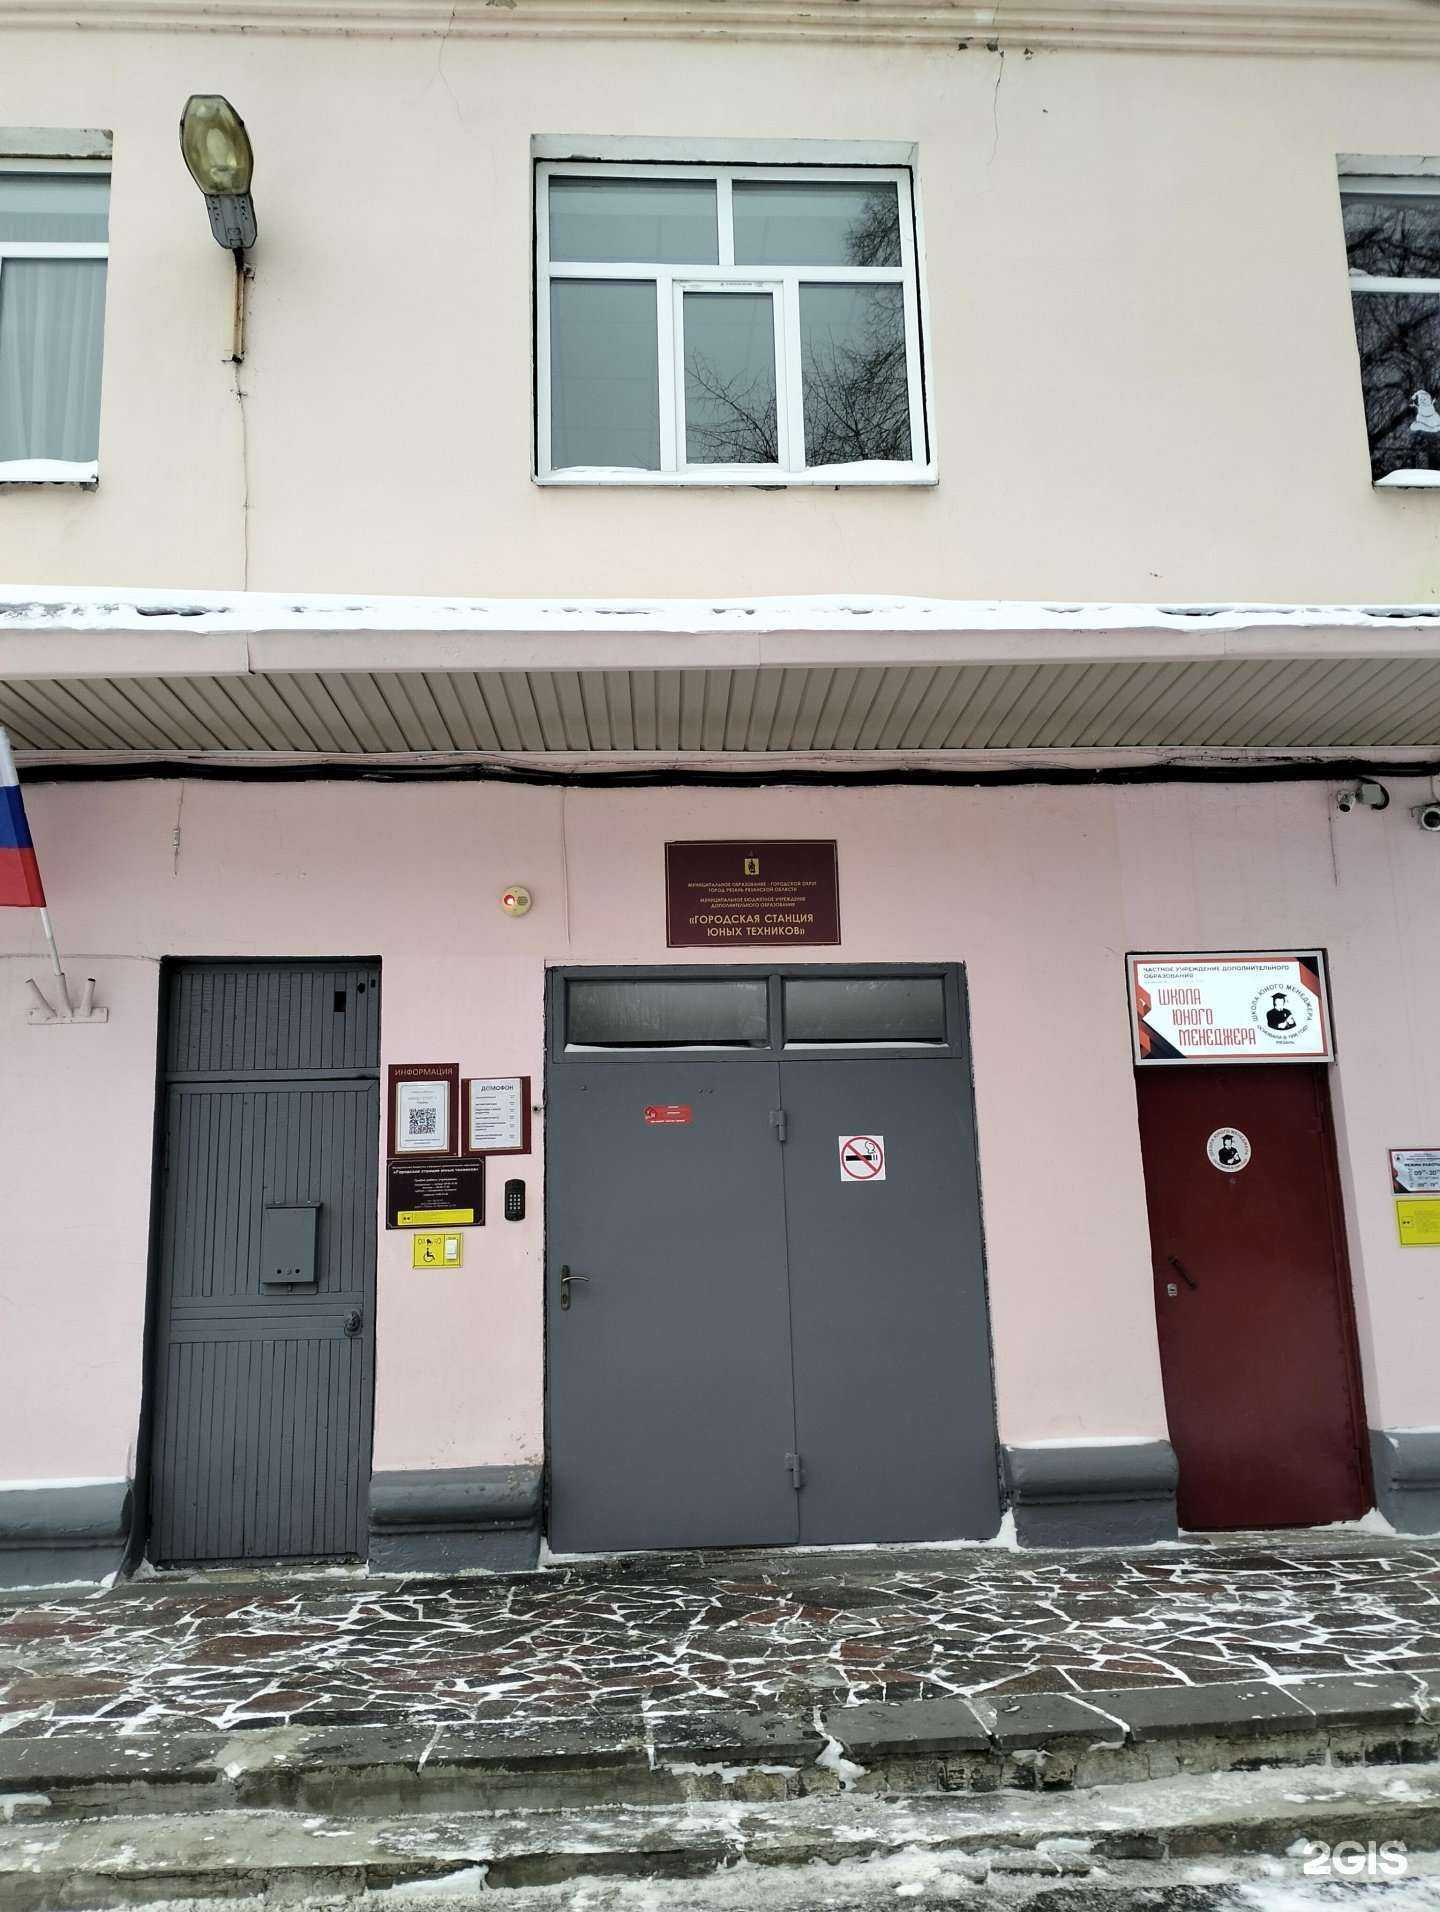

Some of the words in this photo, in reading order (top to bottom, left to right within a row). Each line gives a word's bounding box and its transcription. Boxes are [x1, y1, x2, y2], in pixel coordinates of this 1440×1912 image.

[689, 914, 760, 925] «ГОРОДСКАЯ
[764, 913, 814, 924] СТАНЦИЯ
[707, 927, 743, 937] ЮНЫХ
[746, 926, 805, 936] ТЕХНИКОВ»
[1158, 988, 1201, 1006] ШКОЛА
[1250, 996, 1260, 1022] ШКОЛА
[1258, 983, 1284, 996] ЮНОГО
[1286, 984, 1313, 1021] МЕНЕДЖЕРА
[1172, 1008, 1213, 1026] ЮНОГО
[1178, 1028, 1256, 1046] МЕНЕДЖЕРА
[394, 1067, 454, 1076] ИНФОРМАЦИЯ
